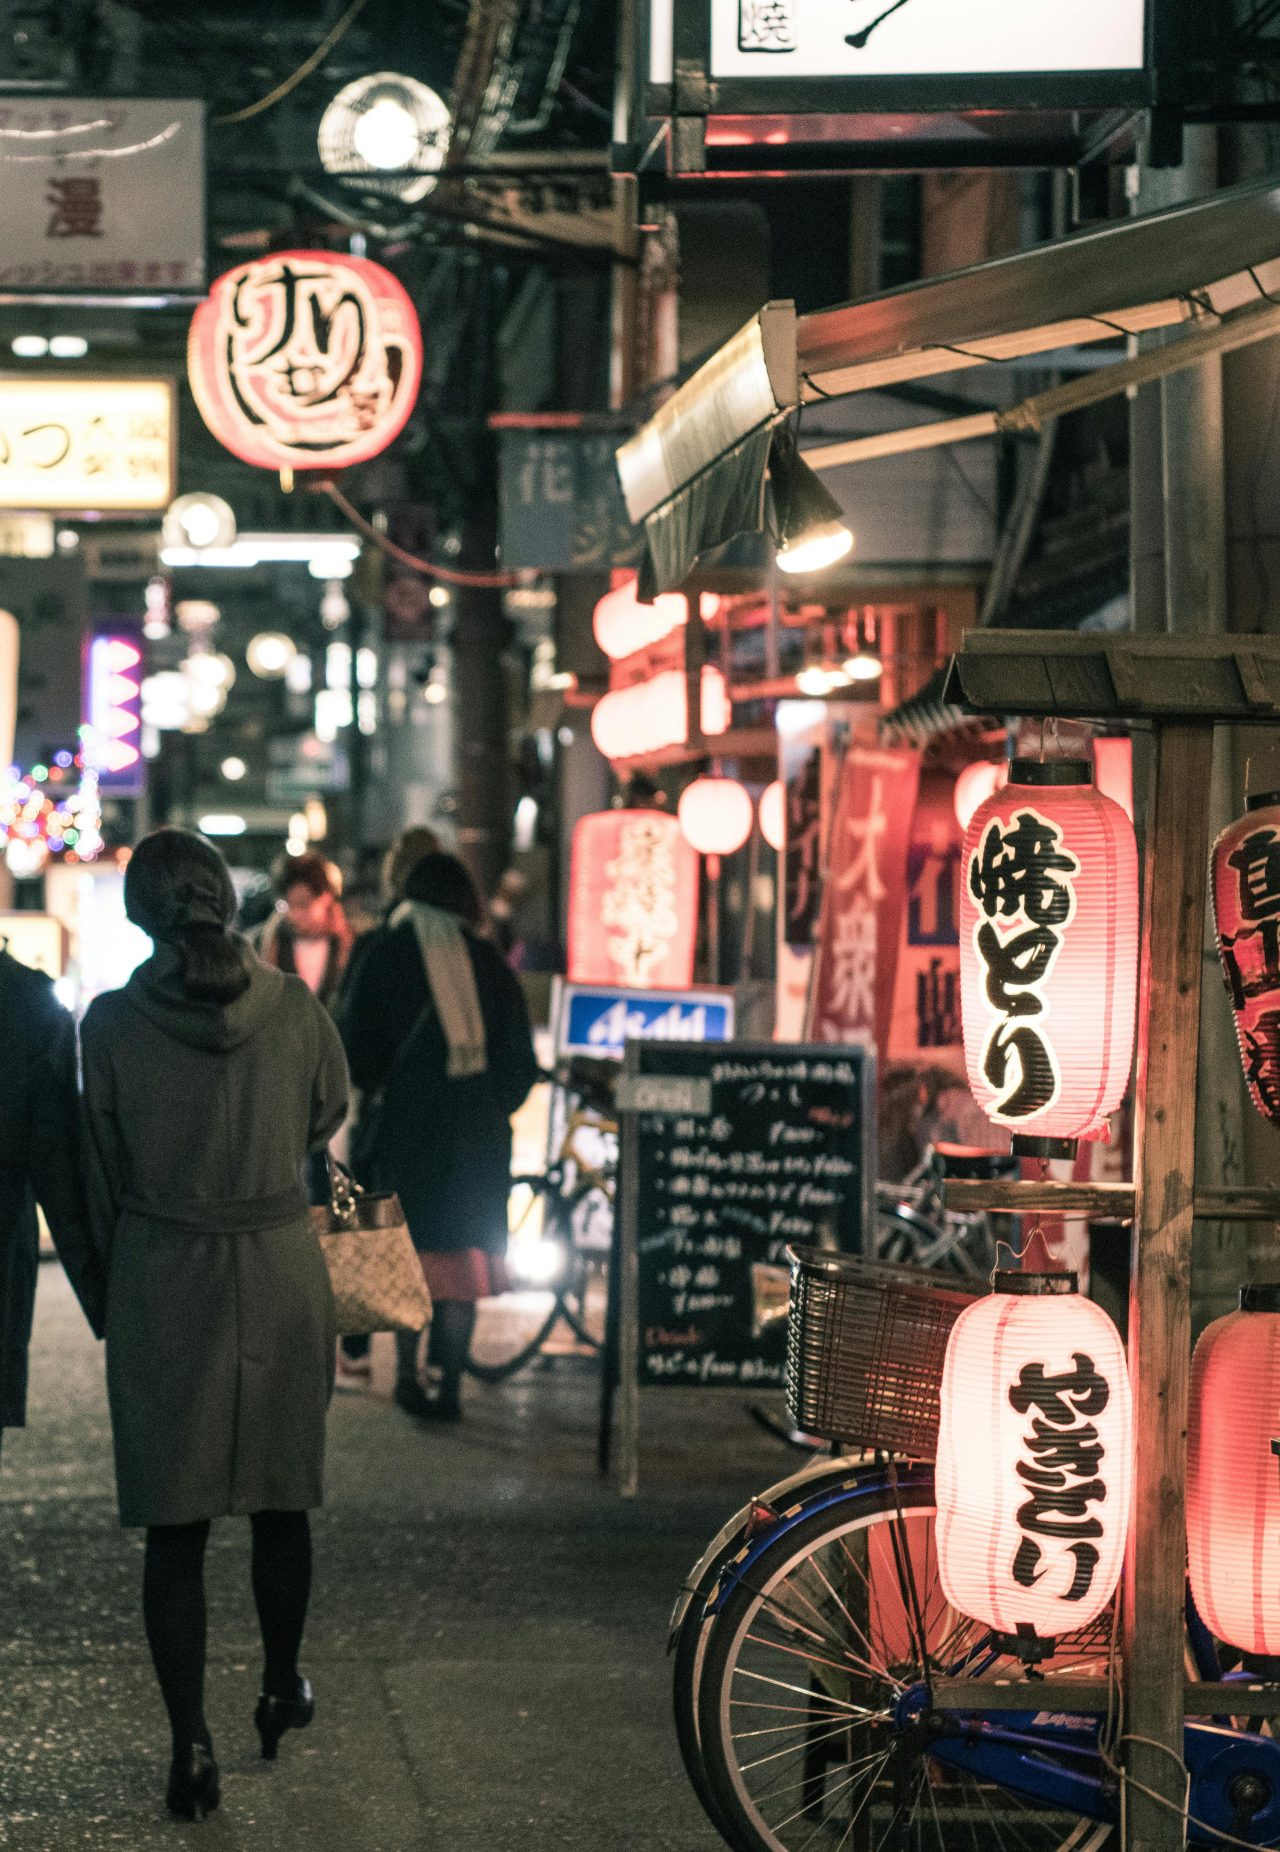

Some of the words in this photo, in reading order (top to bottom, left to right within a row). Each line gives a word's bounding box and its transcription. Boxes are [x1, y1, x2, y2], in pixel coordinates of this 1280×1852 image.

[969, 812, 1078, 1118] 焼とり
[1008, 1352, 1110, 1602] やきとり
